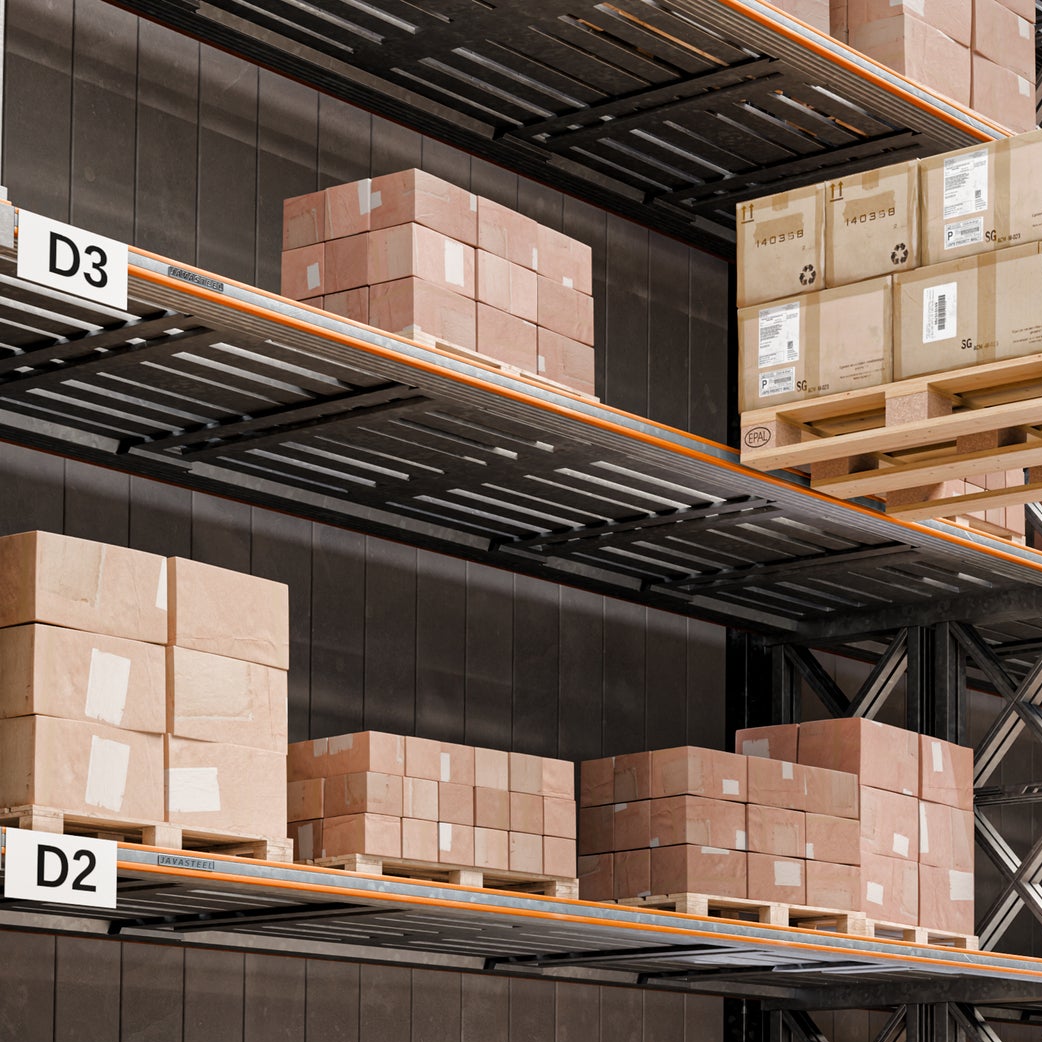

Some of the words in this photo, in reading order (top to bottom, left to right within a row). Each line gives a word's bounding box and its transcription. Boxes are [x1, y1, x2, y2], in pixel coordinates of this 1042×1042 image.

[846, 207, 896, 227] 140358
[947, 231, 954, 241] P
[985, 229, 997, 242] SG
[48, 231, 109, 288] D3
[961, 338, 973, 350] SG
[761, 379, 768, 390] P
[796, 379, 808, 392] SG
[748, 431, 768, 444] EPAL
[37, 843, 97, 893] D2
[159, 855, 213, 870] JAVASTEEL
